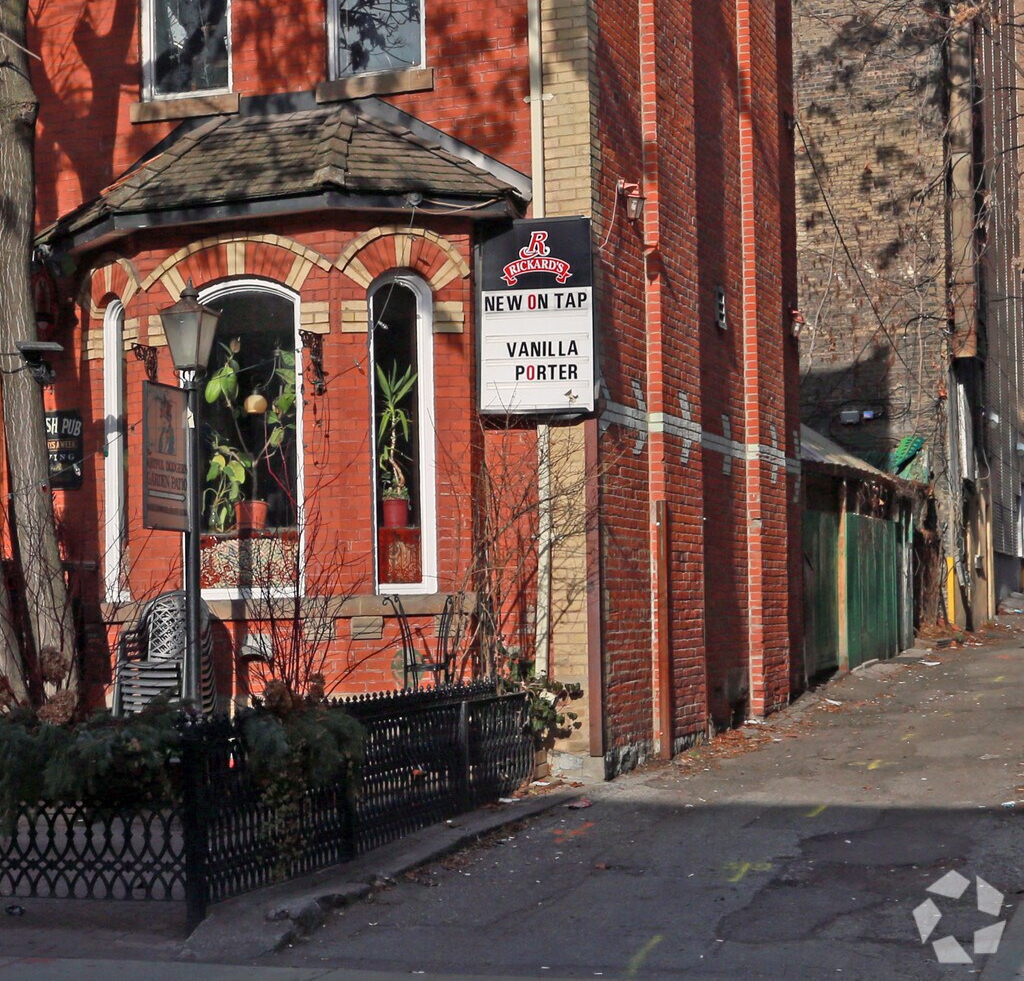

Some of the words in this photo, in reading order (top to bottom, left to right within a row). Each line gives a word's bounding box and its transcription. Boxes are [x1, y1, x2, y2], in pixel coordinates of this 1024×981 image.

[509, 259, 565, 277] RICKARD'S
[485, 295, 523, 312] NEW
[528, 293, 549, 310] ON
[554, 292, 587, 309] TAP
[507, 340, 578, 358] VANILLA
[515, 364, 578, 381] PORTER
[61, 419, 82, 436] PUB
